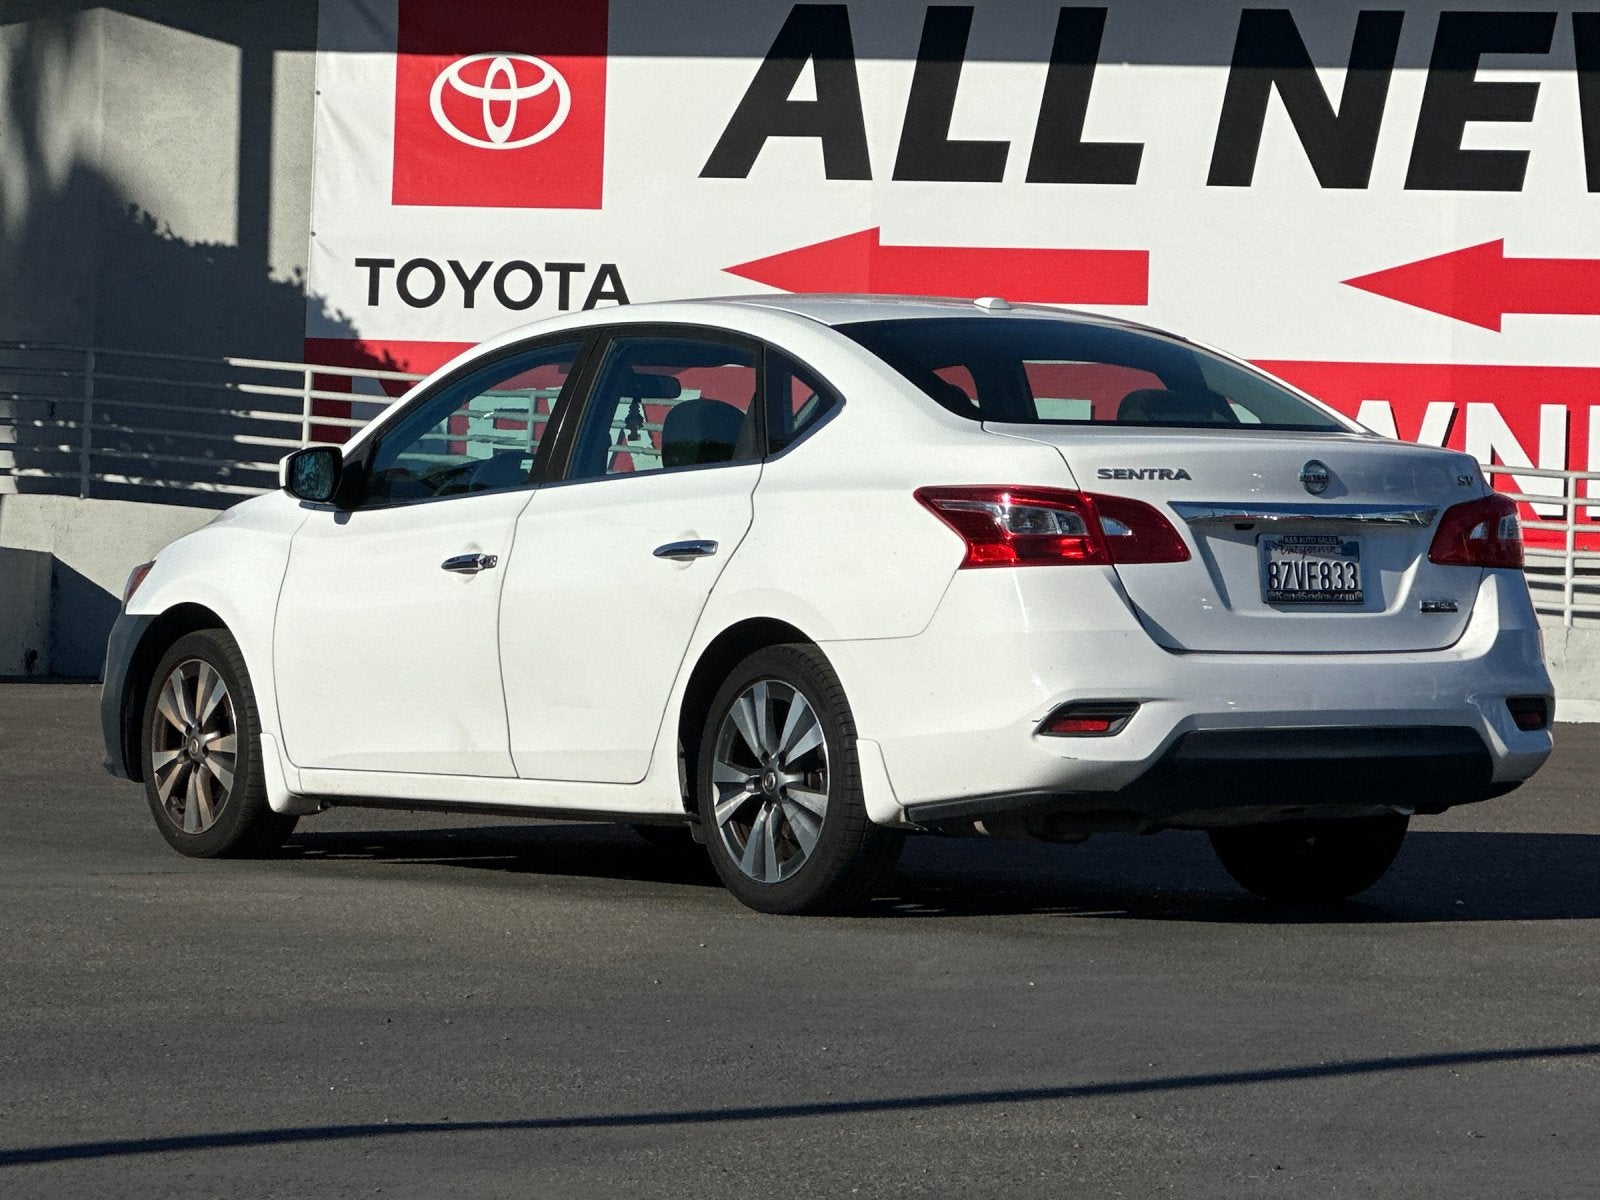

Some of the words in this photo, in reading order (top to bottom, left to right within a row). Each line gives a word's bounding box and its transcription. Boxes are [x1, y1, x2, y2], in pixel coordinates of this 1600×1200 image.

[698, 3, 1145, 186] ALL
[1206, 9, 1600, 193] NE
[354, 257, 632, 311] TOYOTA
[1097, 467, 1192, 481] SENTRA
[1457, 475, 1474, 487] SV
[1299, 536, 1317, 545] AUTO
[1317, 536, 1338, 545] SALES
[1267, 560, 1360, 591] 8ZVF833
